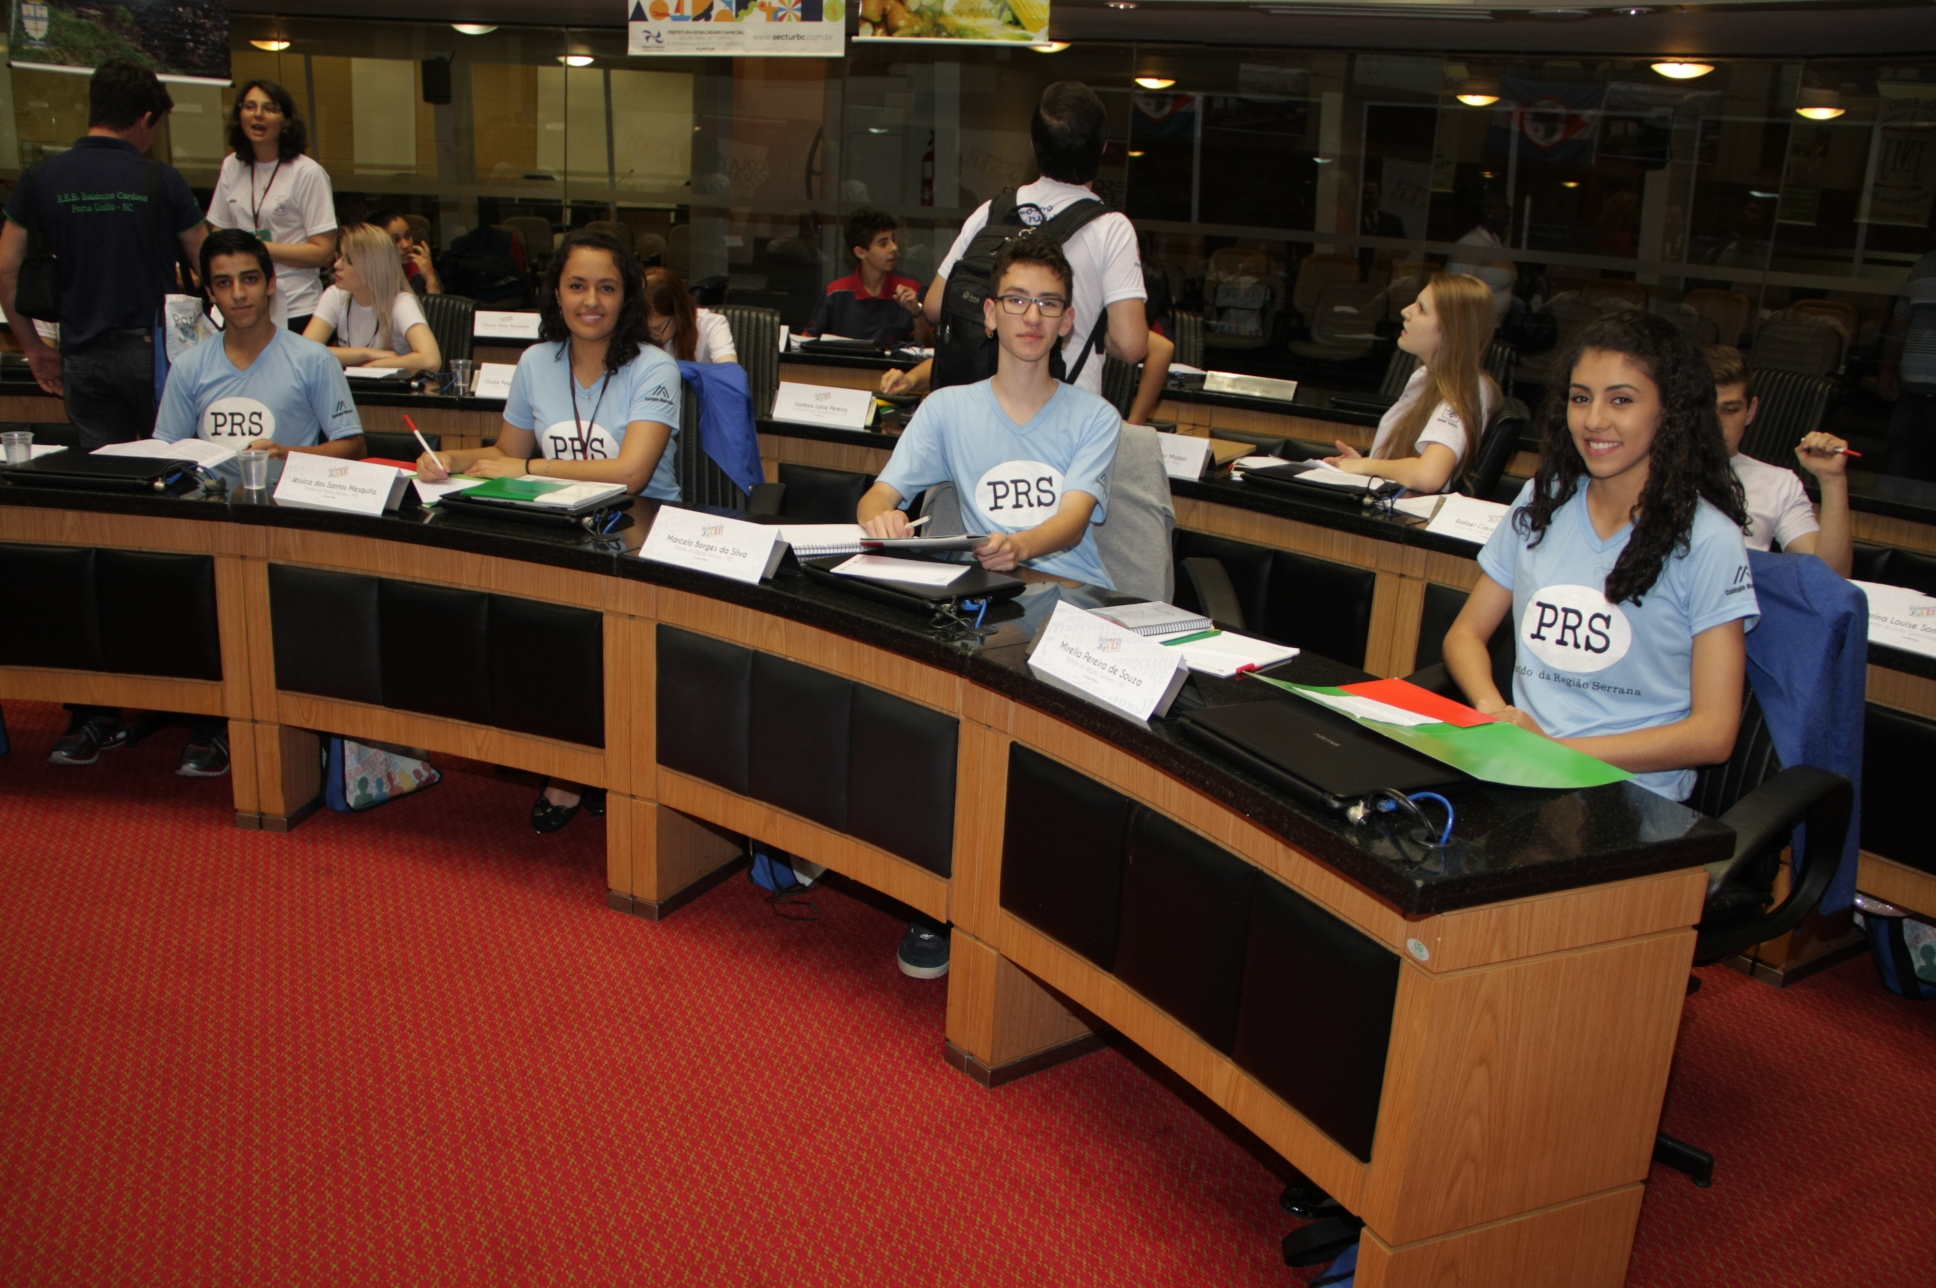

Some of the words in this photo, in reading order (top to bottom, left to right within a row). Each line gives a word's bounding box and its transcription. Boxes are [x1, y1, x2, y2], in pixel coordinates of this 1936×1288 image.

[753, 33, 834, 41] www.secturbc.com.br
[71, 204, 92, 213] Porto
[122, 203, 133, 212] SC
[117, 191, 148, 201] Cardoso
[210, 411, 263, 437] PRS
[327, 481, 347, 491] Santos
[348, 485, 377, 496] Mesquita
[986, 476, 1056, 512] PRS
[666, 534, 693, 547] Marcelo
[695, 541, 717, 553] Borges
[719, 545, 730, 554] da
[731, 547, 748, 559] Silva
[1530, 601, 1611, 654] PRS
[1869, 613, 1888, 622] rina
[1890, 616, 1918, 630] Louise
[1059, 640, 1083, 659] Mirella
[1083, 651, 1106, 670] Pereira
[1108, 664, 1119, 675] de
[1119, 669, 1143, 687] Souza
[1538, 670, 1551, 681] da
[1553, 673, 1589, 690] Região
[1591, 681, 1642, 697] Serrana
